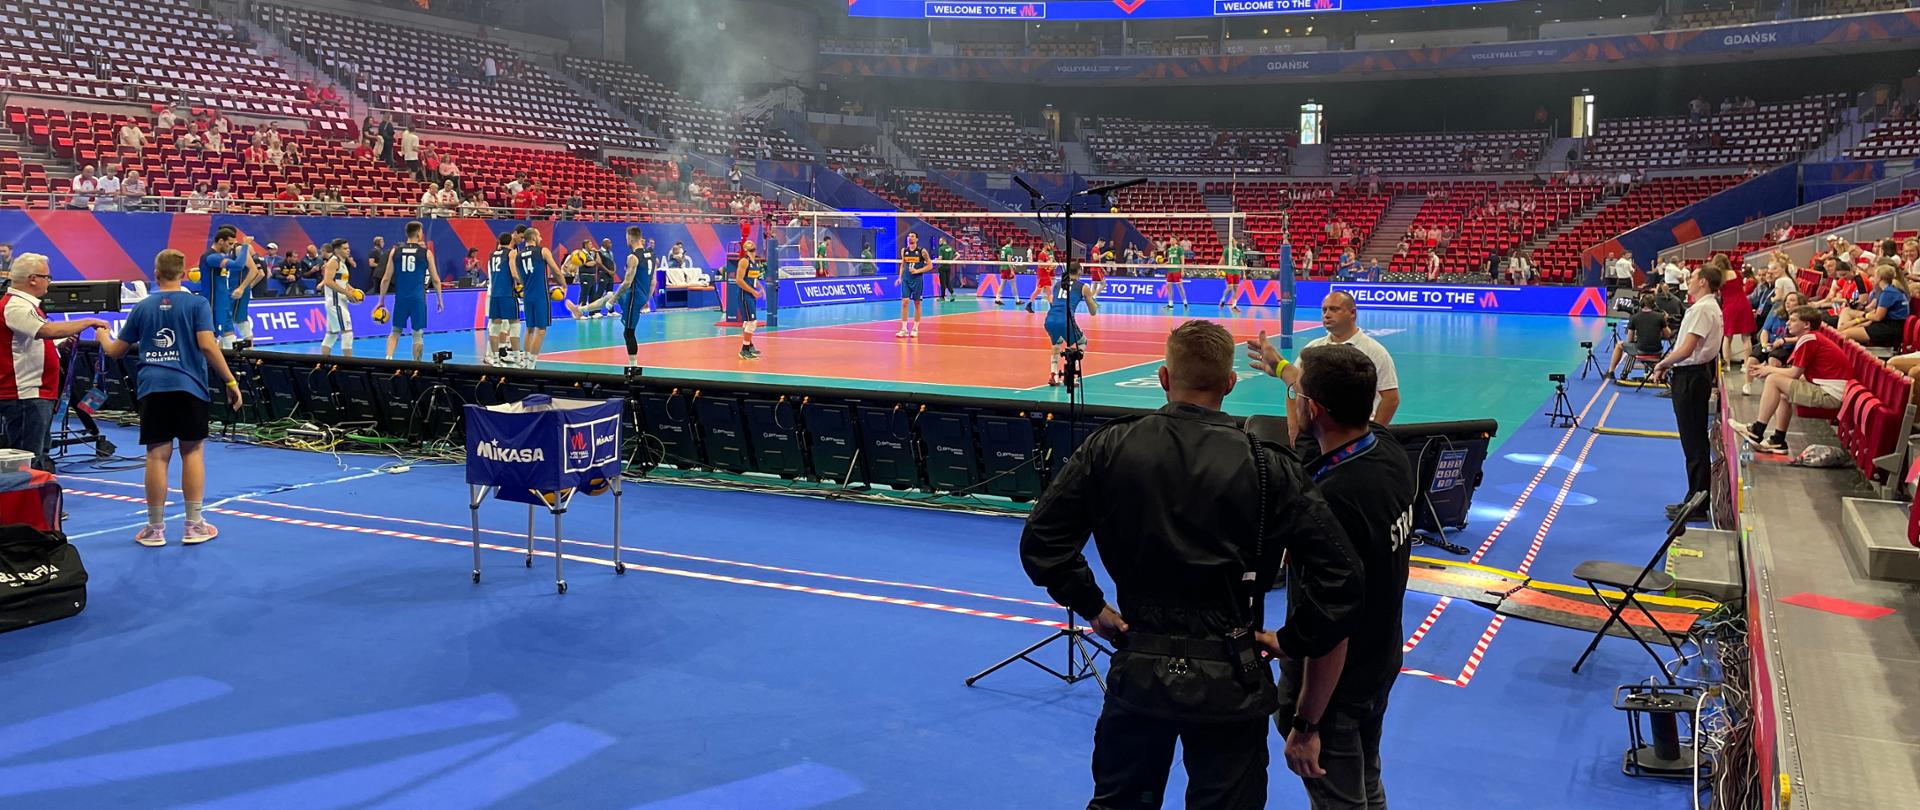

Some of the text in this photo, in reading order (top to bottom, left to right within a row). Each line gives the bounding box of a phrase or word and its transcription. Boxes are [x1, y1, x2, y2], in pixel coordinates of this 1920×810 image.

[934, 5, 982, 14] WELCOME
[984, 6, 997, 14] TO
[999, 6, 1017, 15] THE
[1223, 1, 1274, 11] WELCOME
[1276, 0, 1290, 9] TO
[1292, 0, 1311, 8] THE
[1724, 31, 1777, 46] GDAŃSK
[1267, 58, 1309, 71] GDAŃSK
[401, 255, 416, 272] 16
[492, 256, 501, 272] 12
[521, 257, 534, 275] 14
[804, 284, 873, 297] WELCOME TO THE
[1111, 284, 1127, 294] TO
[1130, 284, 1153, 295] THE
[1422, 291, 1442, 303] TO
[1445, 292, 1475, 304] THE
[256, 311, 300, 330] THE
